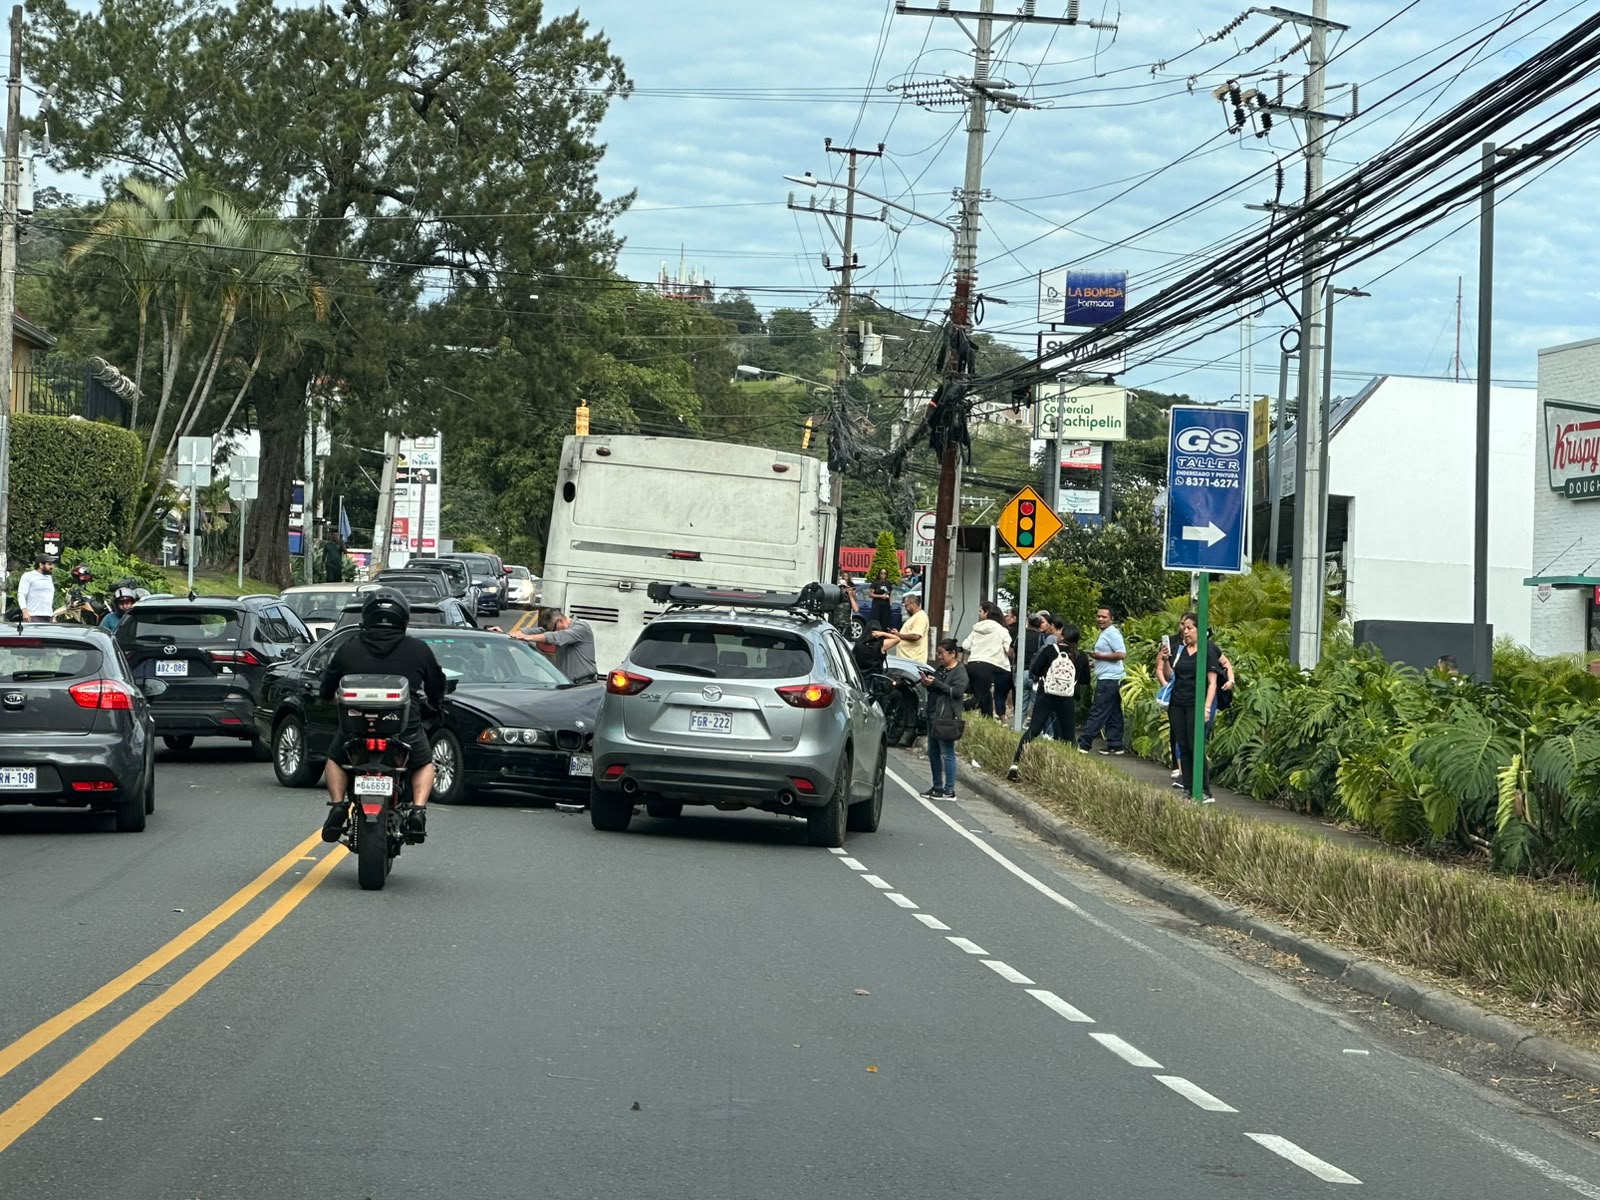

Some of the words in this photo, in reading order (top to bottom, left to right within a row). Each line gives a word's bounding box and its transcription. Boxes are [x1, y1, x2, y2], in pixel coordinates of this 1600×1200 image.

[1068, 287, 1082, 297] LA
[1084, 287, 1123, 298] BOMBA
[1077, 298, 1114, 307] Farmacia
[1176, 427, 1243, 456] GS
[1553, 420, 1600, 473] Krispy
[1177, 457, 1239, 470] TALLER
[1186, 477, 1239, 488] 8371-6274
[691, 715, 730, 729] FGR-222
